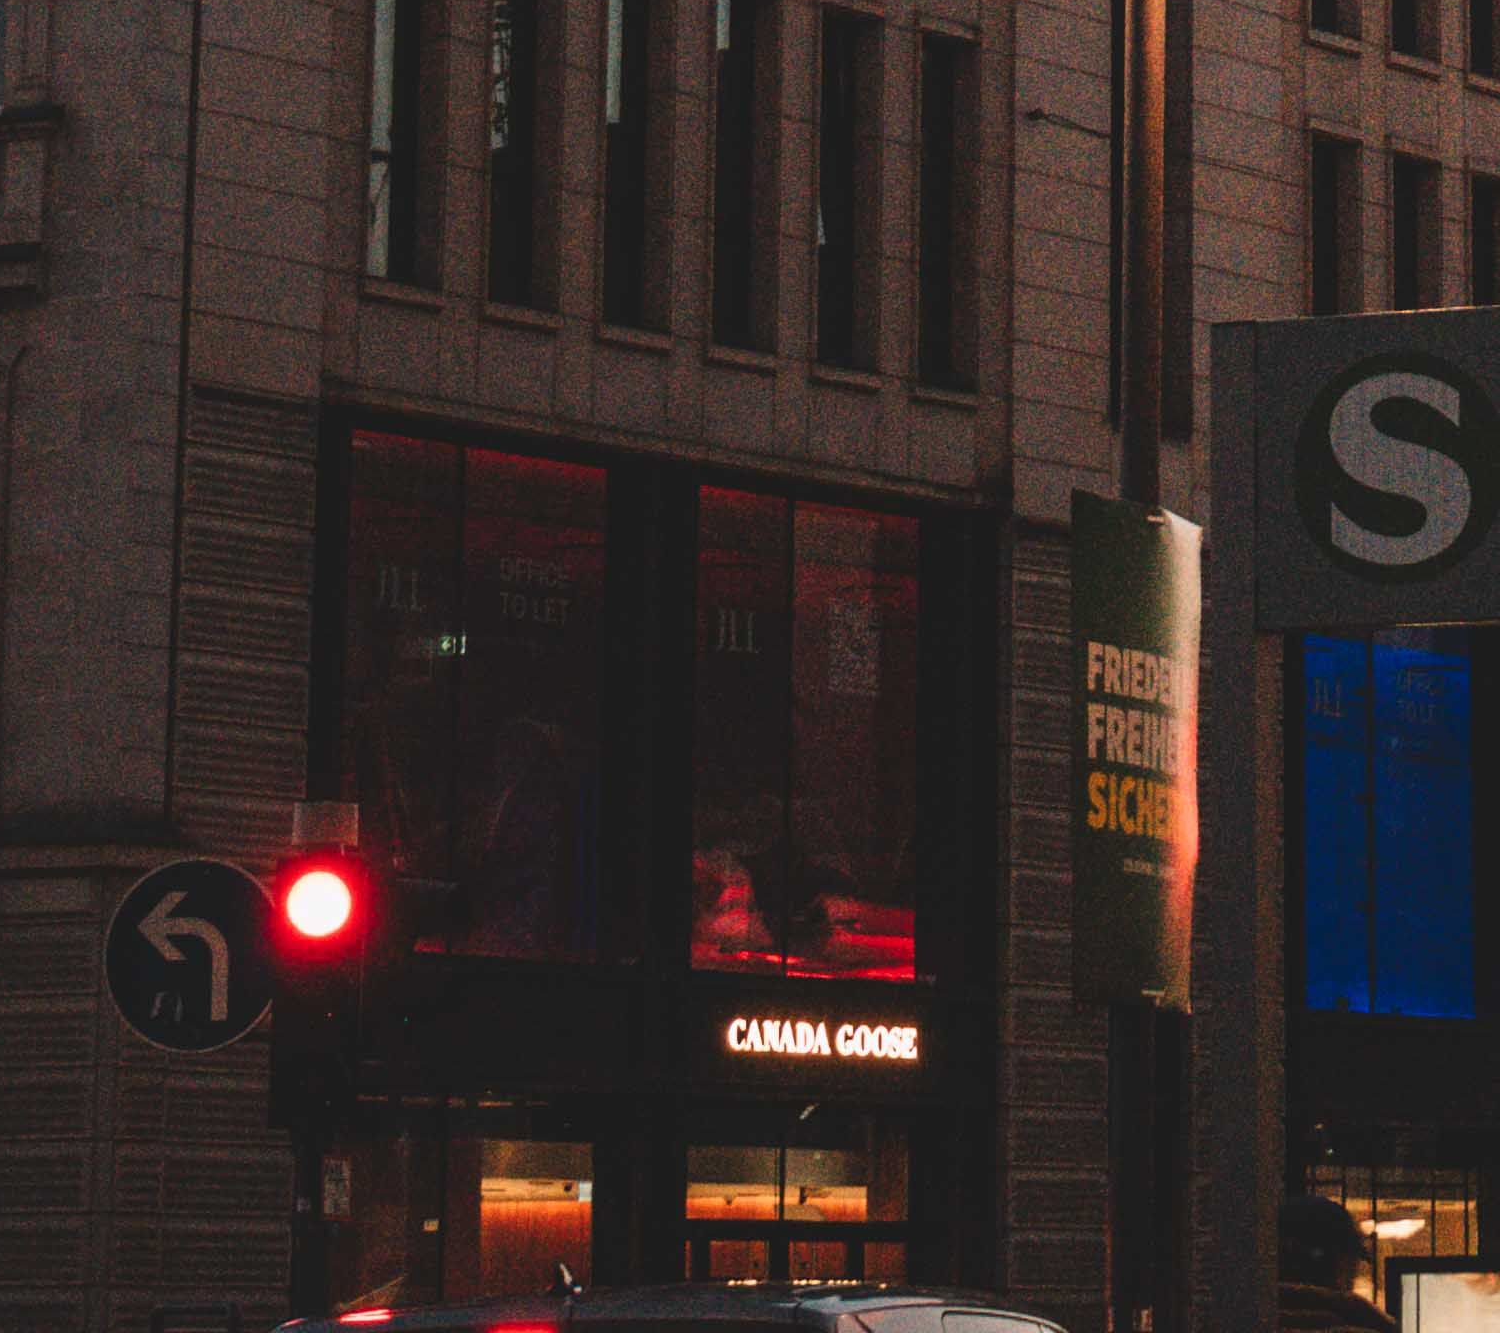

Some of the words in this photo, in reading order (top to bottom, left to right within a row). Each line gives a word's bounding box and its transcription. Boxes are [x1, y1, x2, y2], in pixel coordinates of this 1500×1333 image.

[1328, 371, 1473, 566] S
[728, 1018, 831, 1055] CANADA
[835, 1023, 918, 1059] GOOSE
